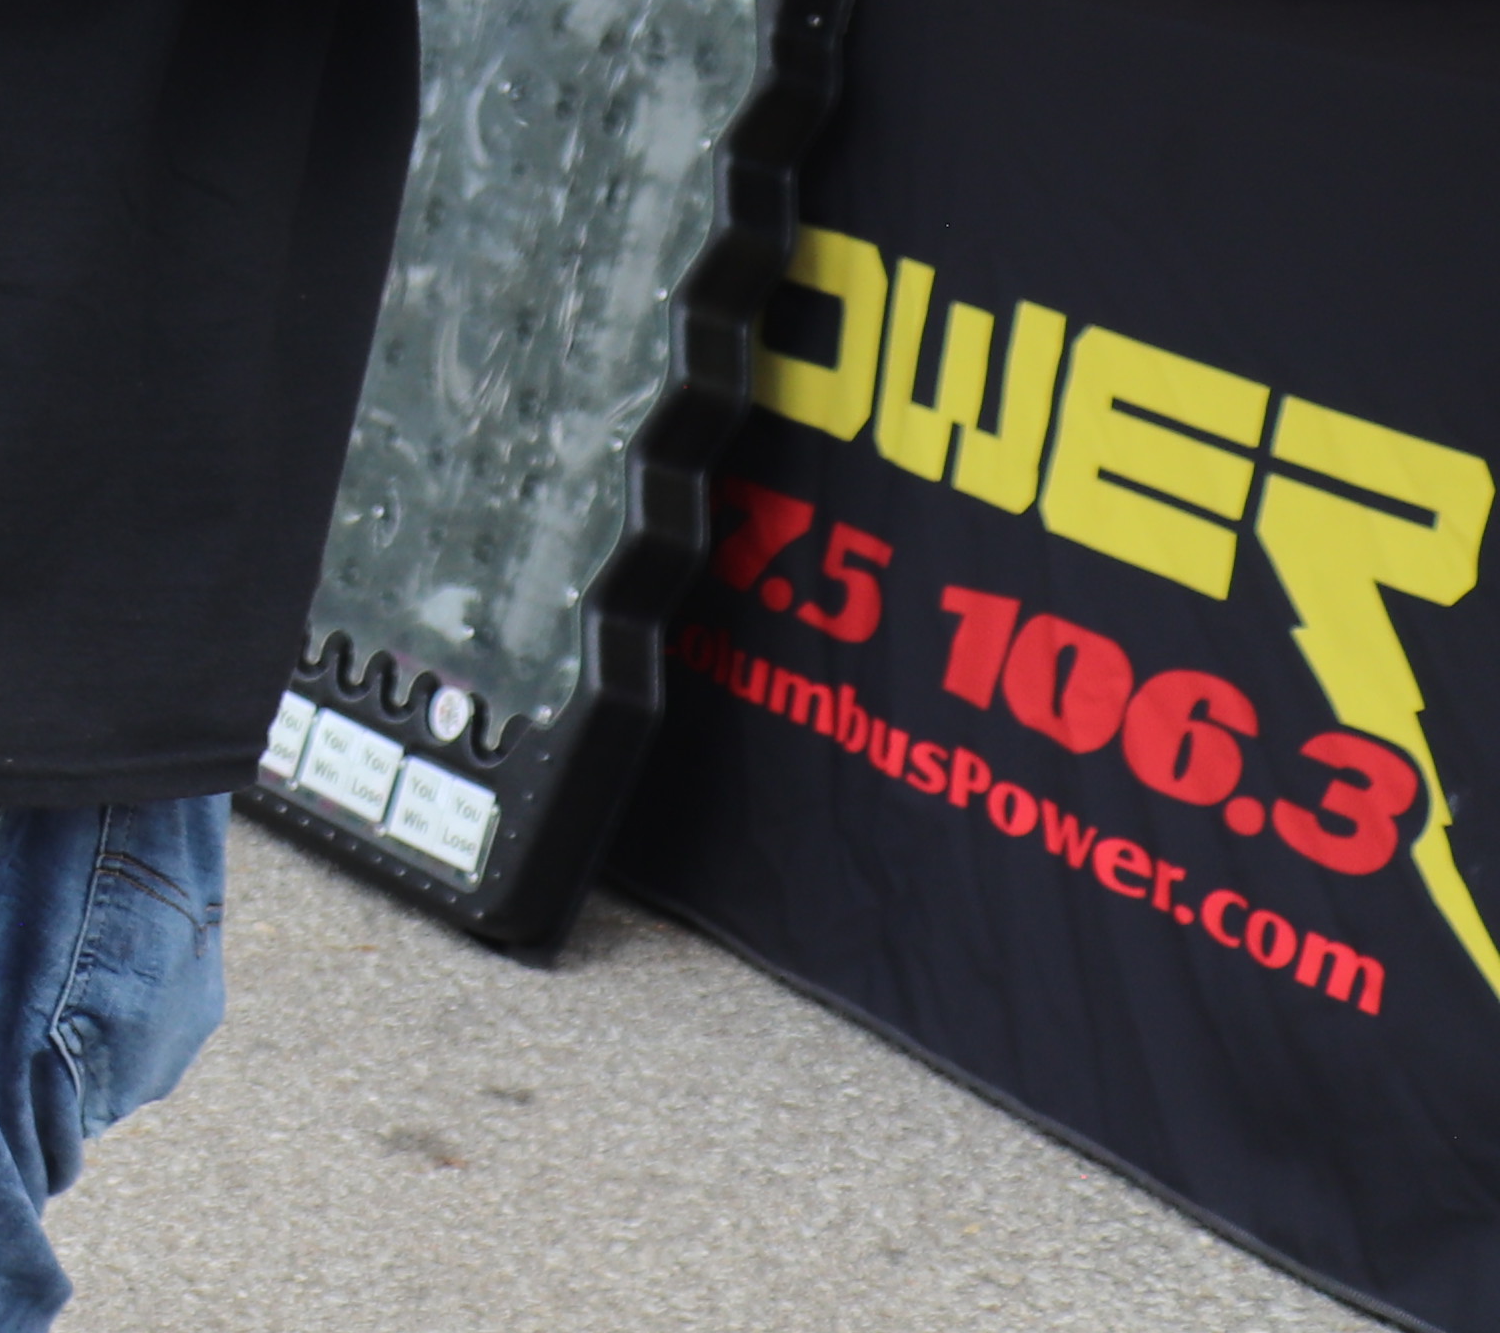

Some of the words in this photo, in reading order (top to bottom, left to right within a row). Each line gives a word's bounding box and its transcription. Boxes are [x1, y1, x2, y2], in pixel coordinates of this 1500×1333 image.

[755, 229, 1500, 1001] OWER
[712, 476, 892, 646] 7.5
[939, 583, 1419, 876] 106.3
[272, 741, 299, 761] ose
[322, 728, 348, 754] You
[315, 758, 340, 785] Win
[363, 747, 390, 775] You
[351, 778, 384, 806] Lose
[411, 775, 437, 802] You
[403, 806, 429, 834] Win
[455, 795, 483, 823] You
[666, 624, 1386, 1017] olumbusPower.com
[442, 825, 477, 856] Lose
